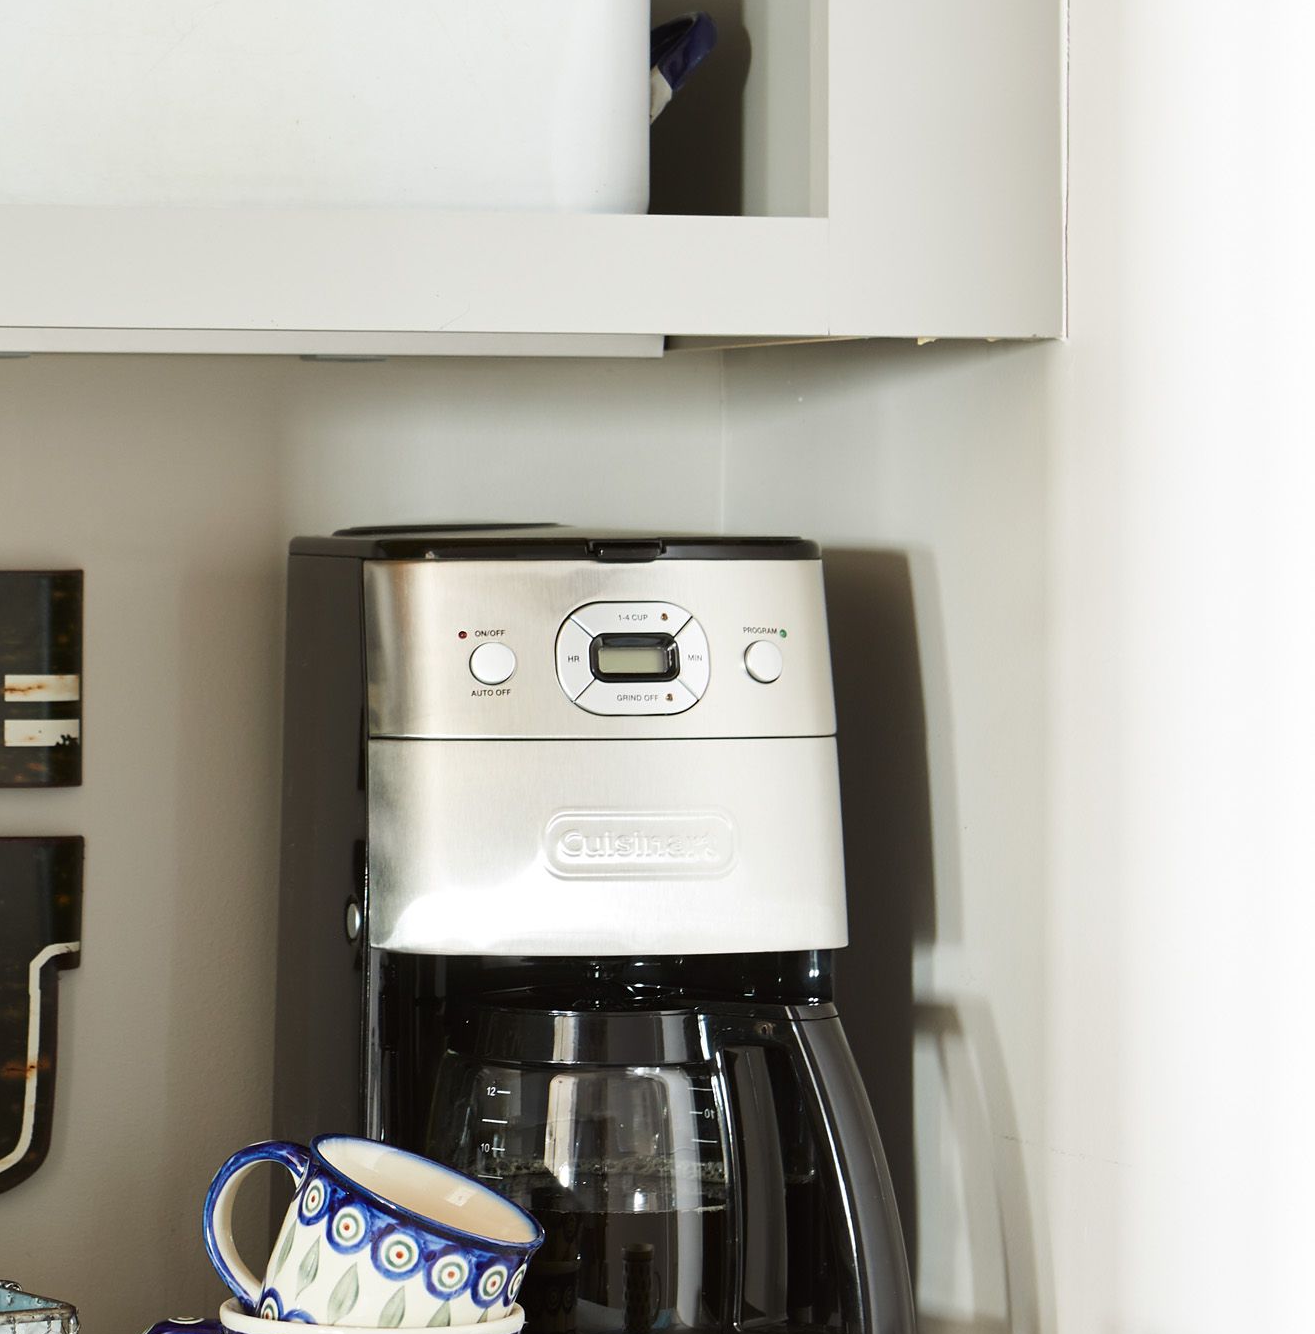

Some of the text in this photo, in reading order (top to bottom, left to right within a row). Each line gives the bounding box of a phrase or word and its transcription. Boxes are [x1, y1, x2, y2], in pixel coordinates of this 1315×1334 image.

[618, 613, 649, 621] 1-4 CUP
[474, 629, 506, 637] ON/OFF
[742, 626, 778, 635] PROGRAM
[567, 655, 580, 663] HR
[687, 654, 703, 662] MIN
[470, 688, 511, 697] AUTO OFF
[616, 694, 659, 702] GRIND OFF
[557, 828, 720, 860] Cuisinart
[486, 1086, 497, 1097] 12
[481, 1143, 490, 1153] 10
